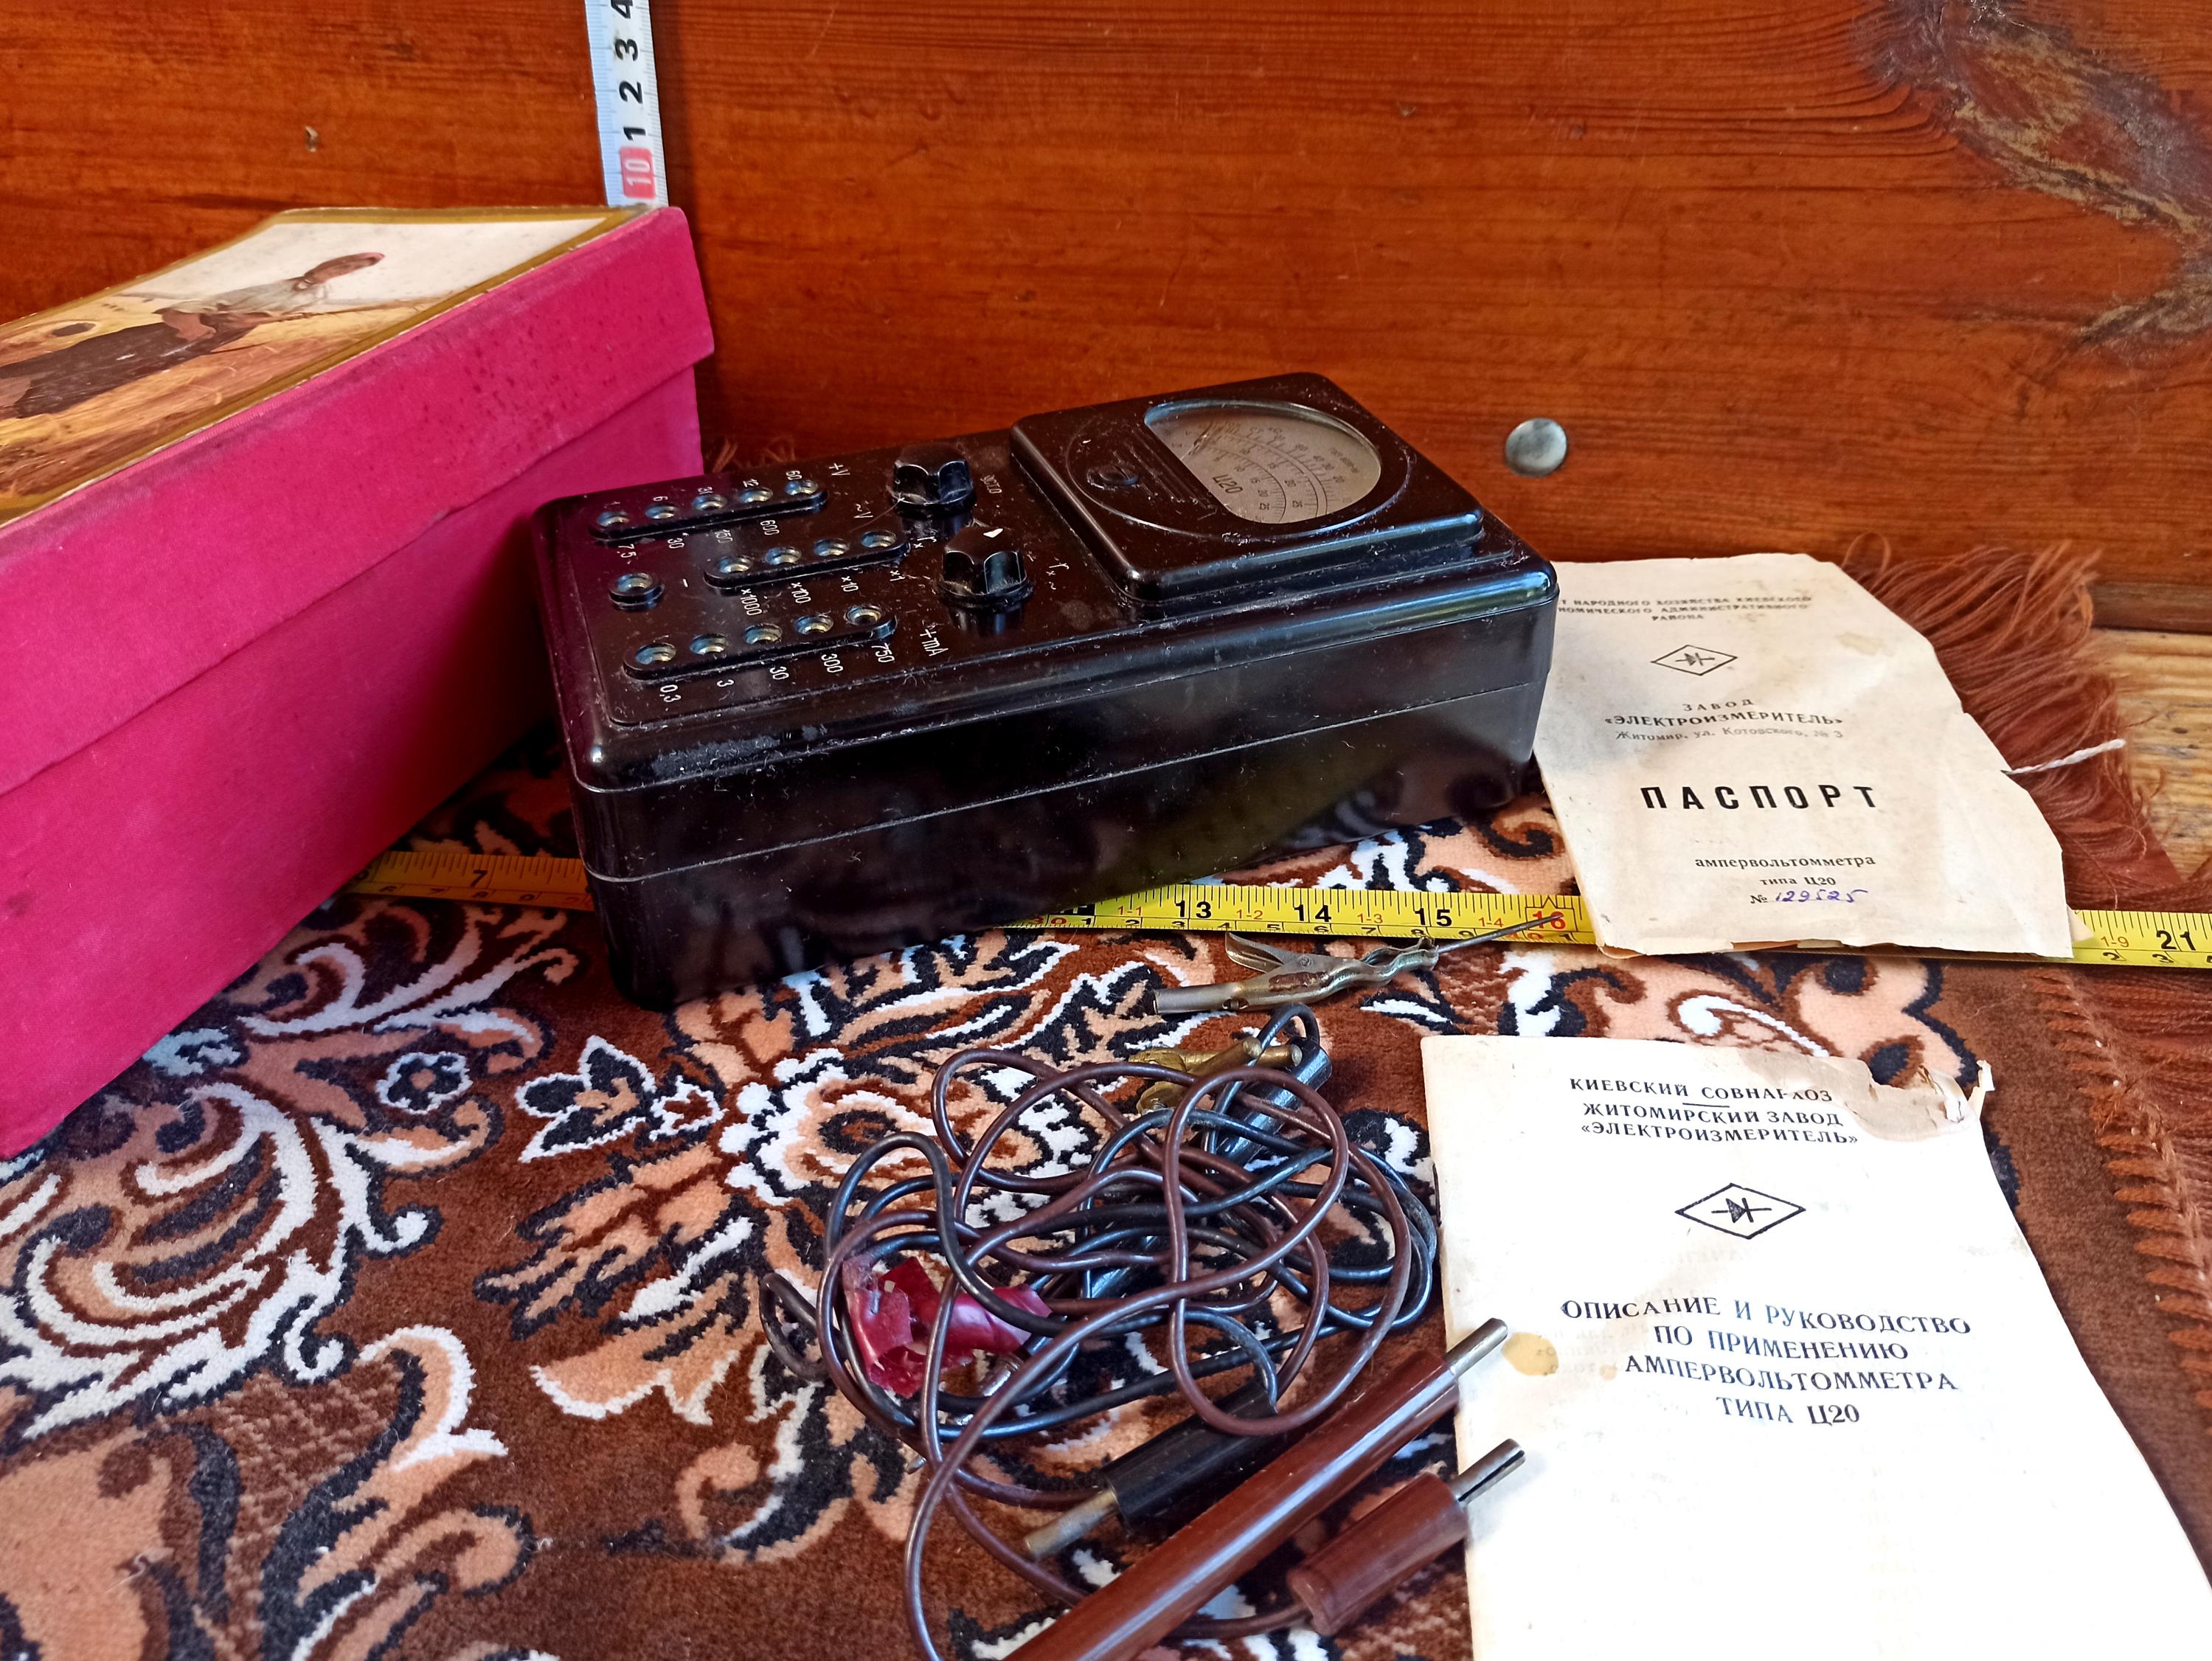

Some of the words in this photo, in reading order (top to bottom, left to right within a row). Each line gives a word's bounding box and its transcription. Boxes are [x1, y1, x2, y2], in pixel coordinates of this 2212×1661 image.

[614, 38, 639, 61] 3
[619, 81, 643, 104] 2
[623, 126, 646, 141] 1
[625, 158, 652, 187] 10
[1212, 474, 1244, 493] Ц20
[760, 519, 780, 535] 600
[668, 537, 684, 549] 30
[871, 643, 895, 664] 750
[769, 665, 790, 681] 30
[821, 653, 845, 674] 300
[716, 679, 735, 688] 3
[1682, 698, 1754, 712] ЗАВОД
[1604, 711, 1842, 727] «ЭЛЕКТРОИЗМЕРИТЕЛЬ»
[1640, 784, 1877, 810] ПАСПОРТ
[1695, 855, 1876, 870] ампервольтомметра
[471, 869, 488, 887] 7
[1760, 877, 1797, 886] типа
[1805, 875, 1836, 887] Ц20
[1175, 900, 1212, 919] 13
[1294, 904, 1332, 923] 14
[1415, 908, 1452, 927] 15
[2156, 929, 2197, 951] 21
[1570, 1078, 1689, 1097] КИЕВСКИЙ
[1583, 1103, 1760, 1124] ЖИТОМИРСКИЙ
[1768, 1111, 1844, 1127] ЗАВОД
[1581, 1121, 1859, 1144] «ЭЛЕКТРОИЗМЕРИТЕЛЬ»
[1561, 1296, 1722, 1320] ОПИСАНИЕ
[1733, 1300, 1752, 1320] И
[1765, 1303, 1972, 1335] РУКОВОДСТВО
[1654, 1325, 1693, 1347] ПО
[1708, 1329, 1909, 1360] ПРИМЕНЕНИЮ
[1625, 1354, 1959, 1392] АМПЕРВОЛЬТОММЕТРА
[1716, 1396, 1794, 1424] ТИПА
[1806, 1404, 1860, 1426] Ц20
